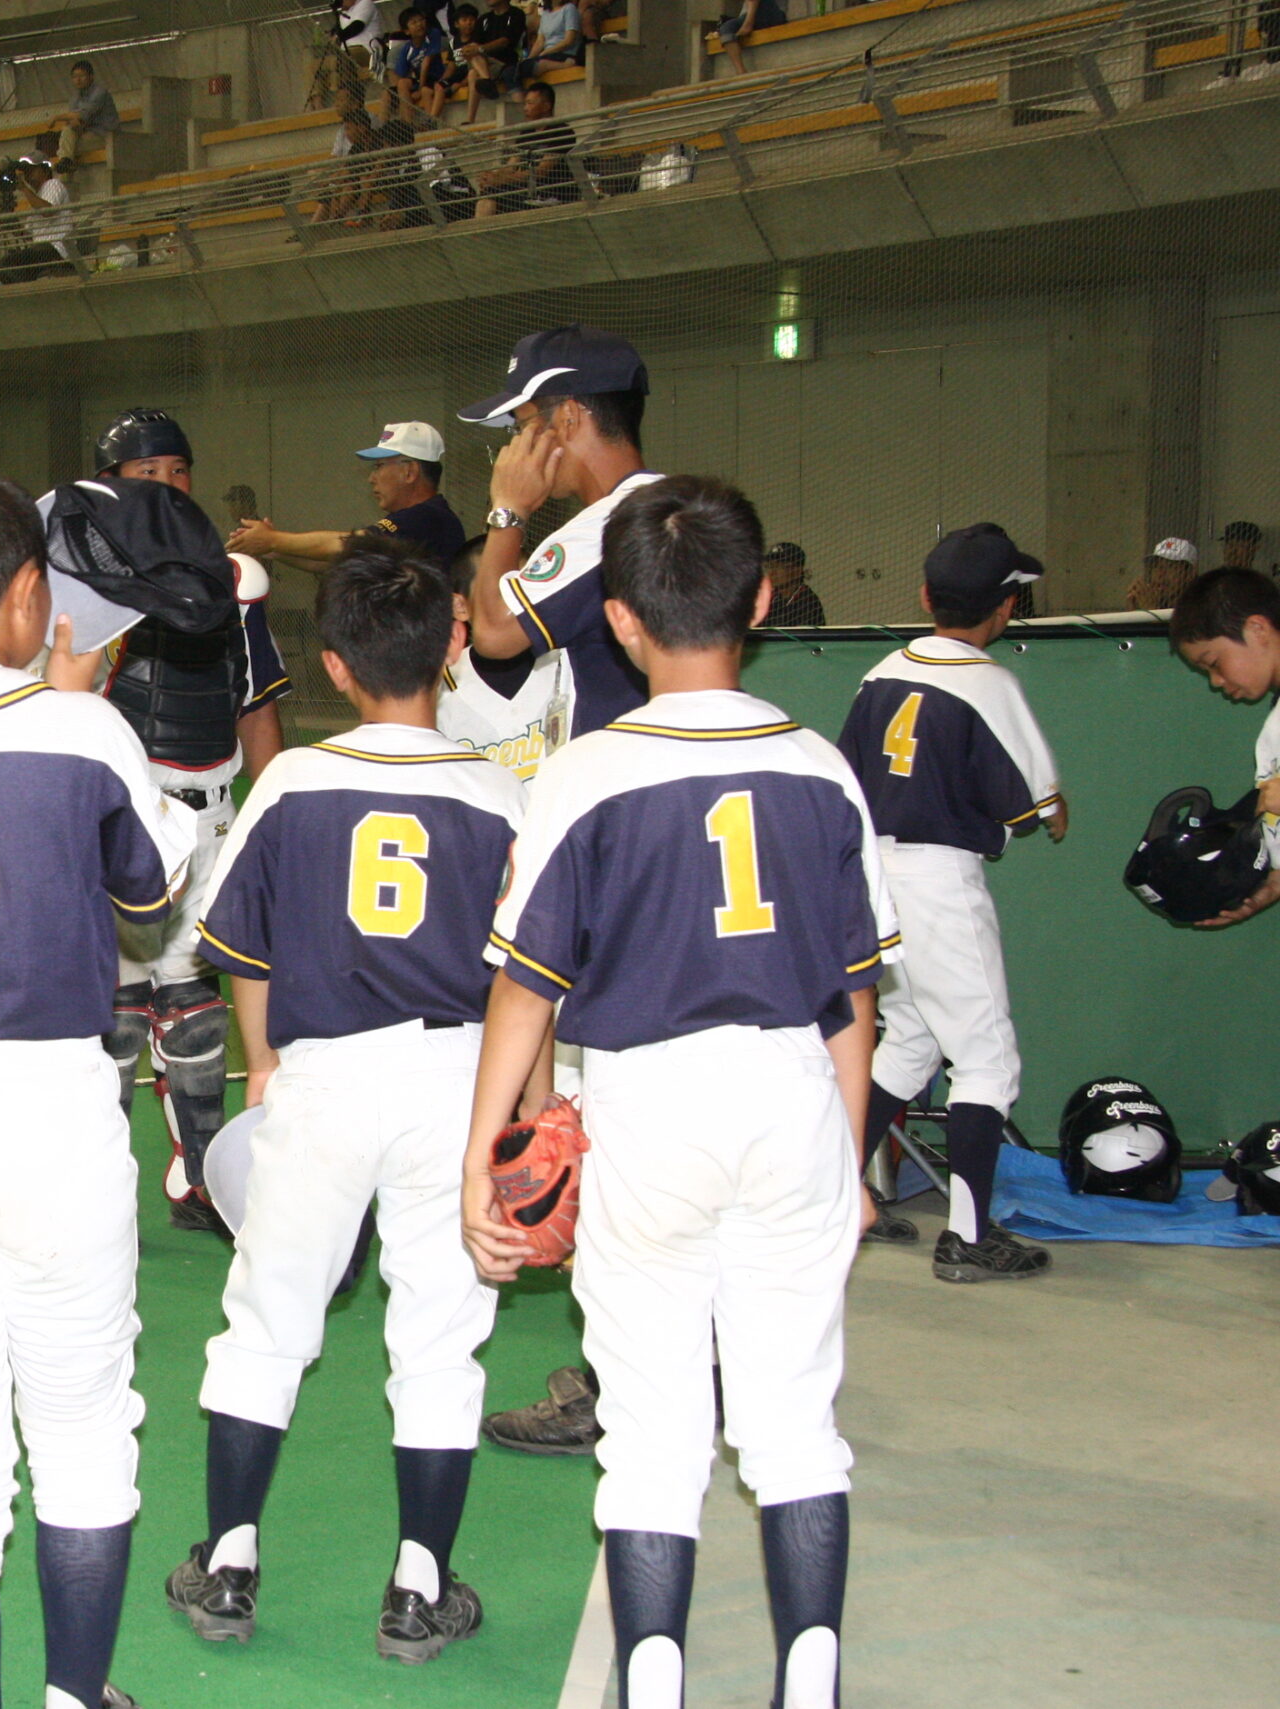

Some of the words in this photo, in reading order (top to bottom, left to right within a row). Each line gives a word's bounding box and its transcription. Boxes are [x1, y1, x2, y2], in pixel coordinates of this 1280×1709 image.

[882, 692, 924, 777] 4
[347, 810, 429, 938] 6
[705, 790, 776, 938] 1
[1087, 1081, 1142, 1098] Greenboys
[1106, 1101, 1162, 1119] Greenboys
